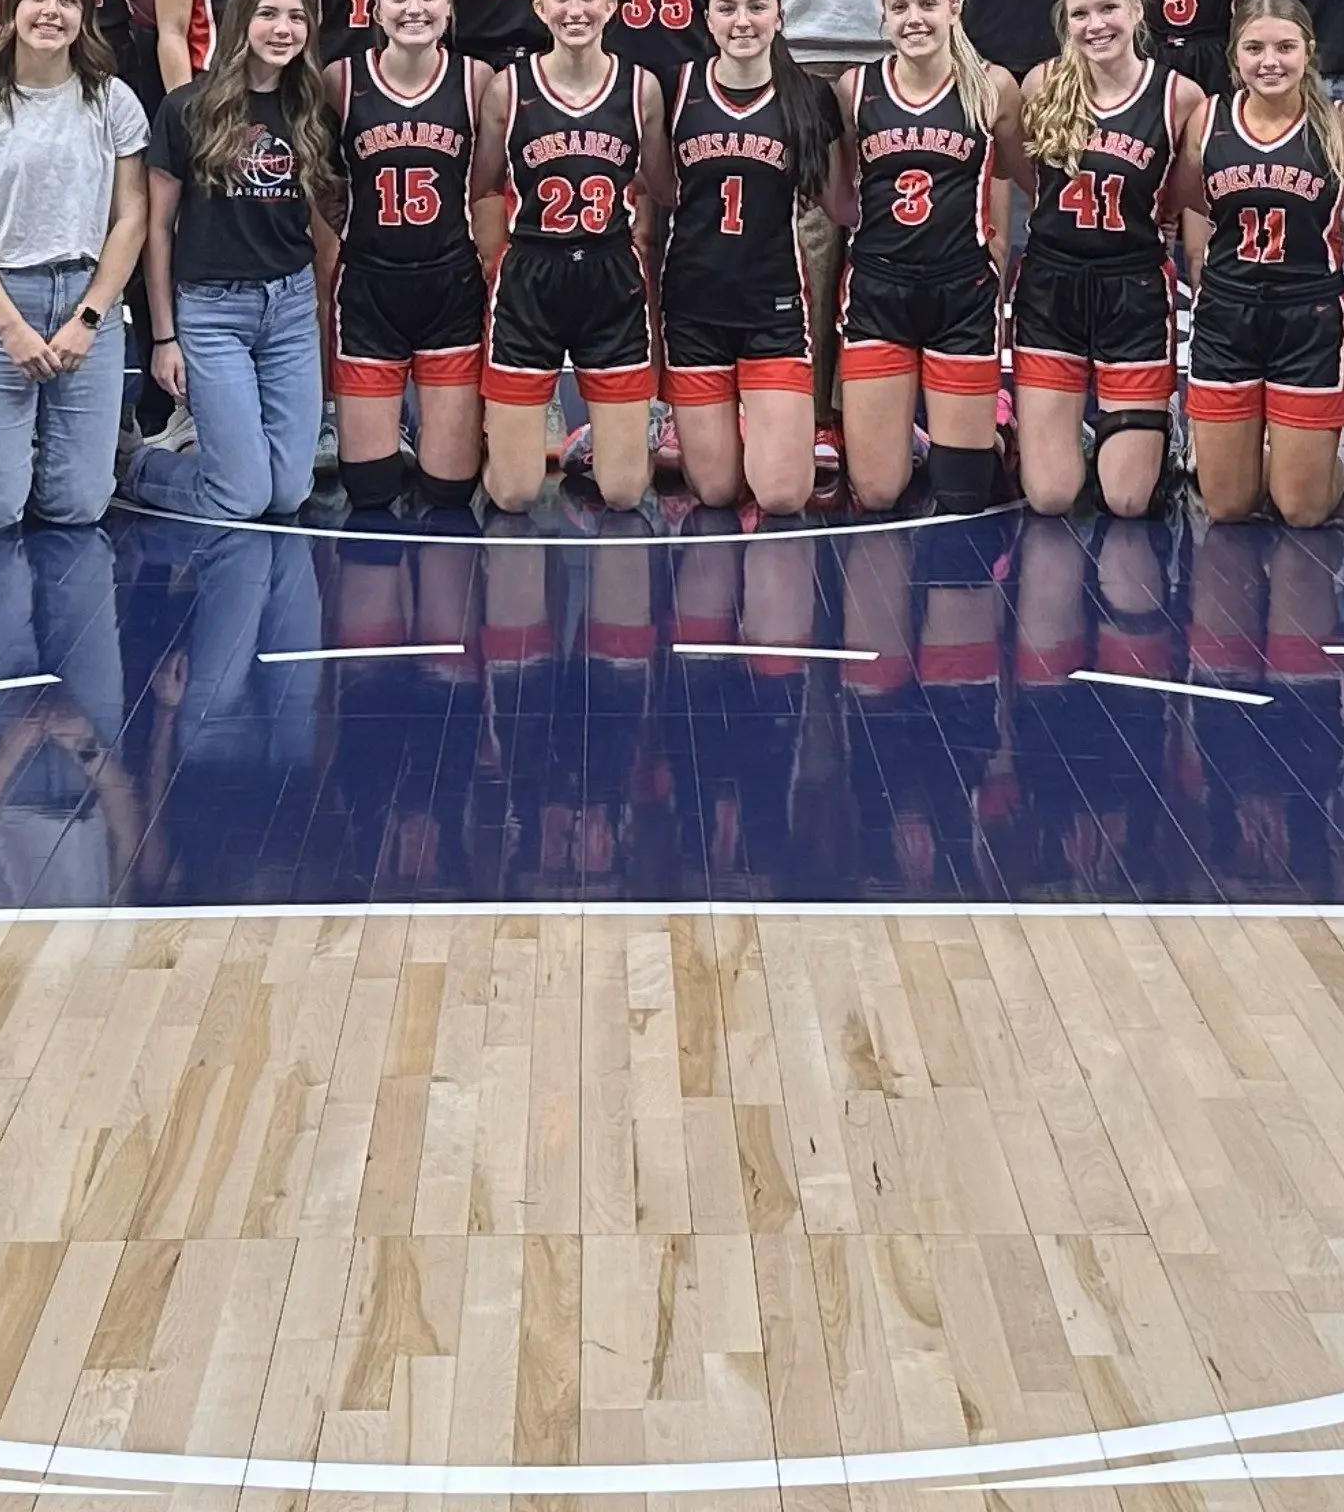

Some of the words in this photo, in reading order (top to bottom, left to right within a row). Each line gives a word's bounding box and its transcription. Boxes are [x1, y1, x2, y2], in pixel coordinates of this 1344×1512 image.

[355, 121, 465, 160] CRUSADERS
[522, 130, 632, 169] CRUSADERS
[861, 126, 976, 163] CRUSADERS
[375, 167, 442, 226] 15
[537, 175, 615, 234] 23
[720, 176, 744, 235] 1
[891, 169, 934, 226] 3
[1059, 170, 1126, 232] 41
[1207, 164, 1325, 202] CRUSADERS
[1236, 207, 1288, 264] 11
